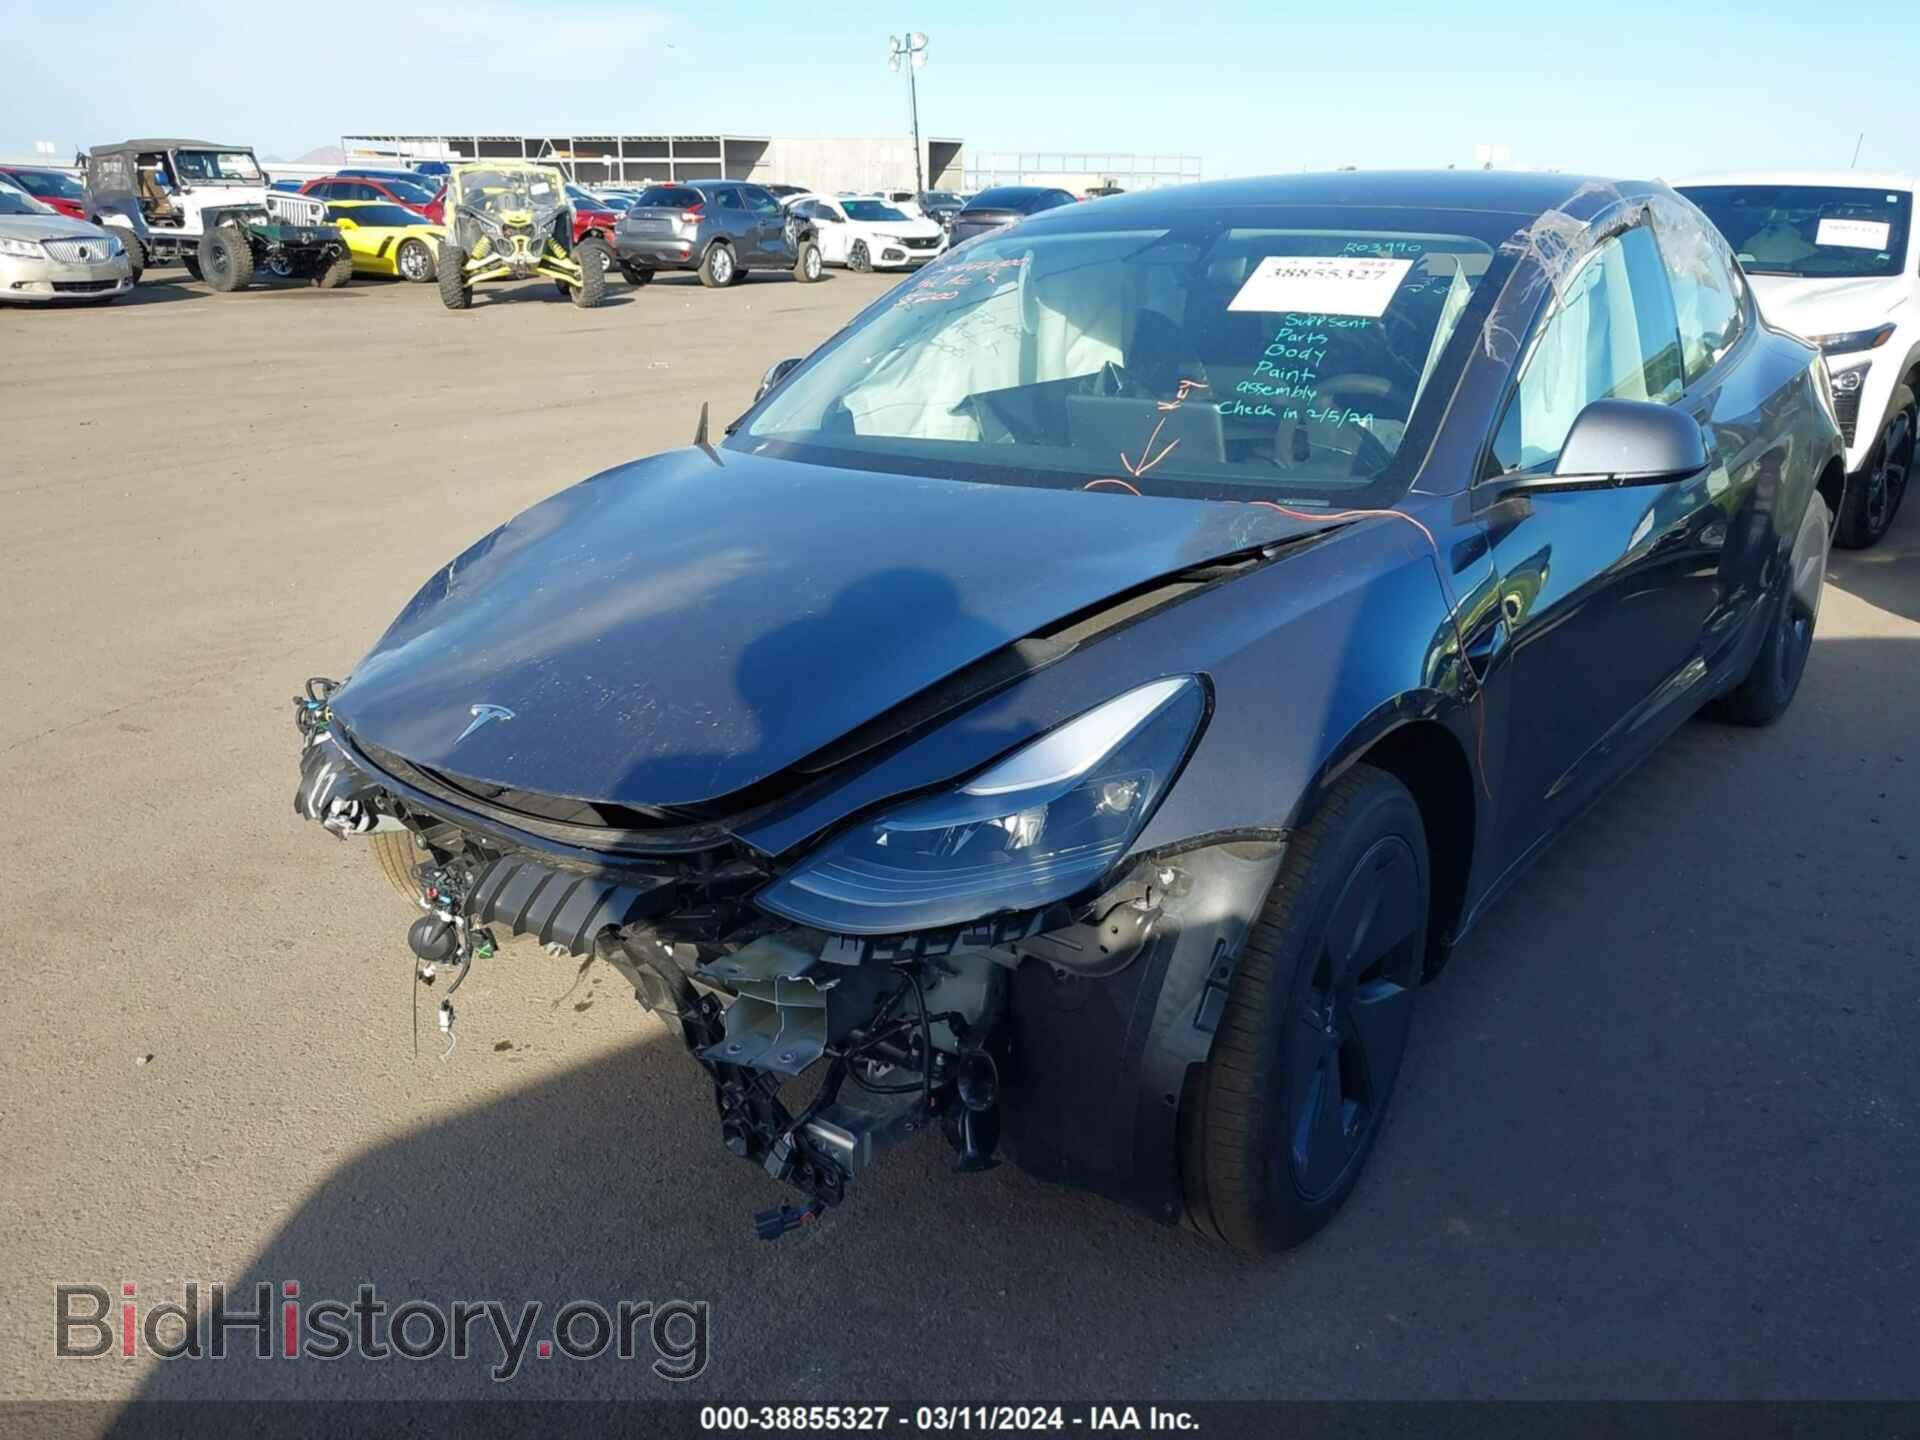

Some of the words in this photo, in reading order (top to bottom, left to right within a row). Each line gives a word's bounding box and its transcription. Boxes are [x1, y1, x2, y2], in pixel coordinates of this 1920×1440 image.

[1275, 328, 1328, 344] Parts
[1264, 343, 1327, 367] Body
[1254, 360, 1316, 383] Paint
[1217, 400, 1276, 416] Check
[1283, 407, 1298, 419] in
